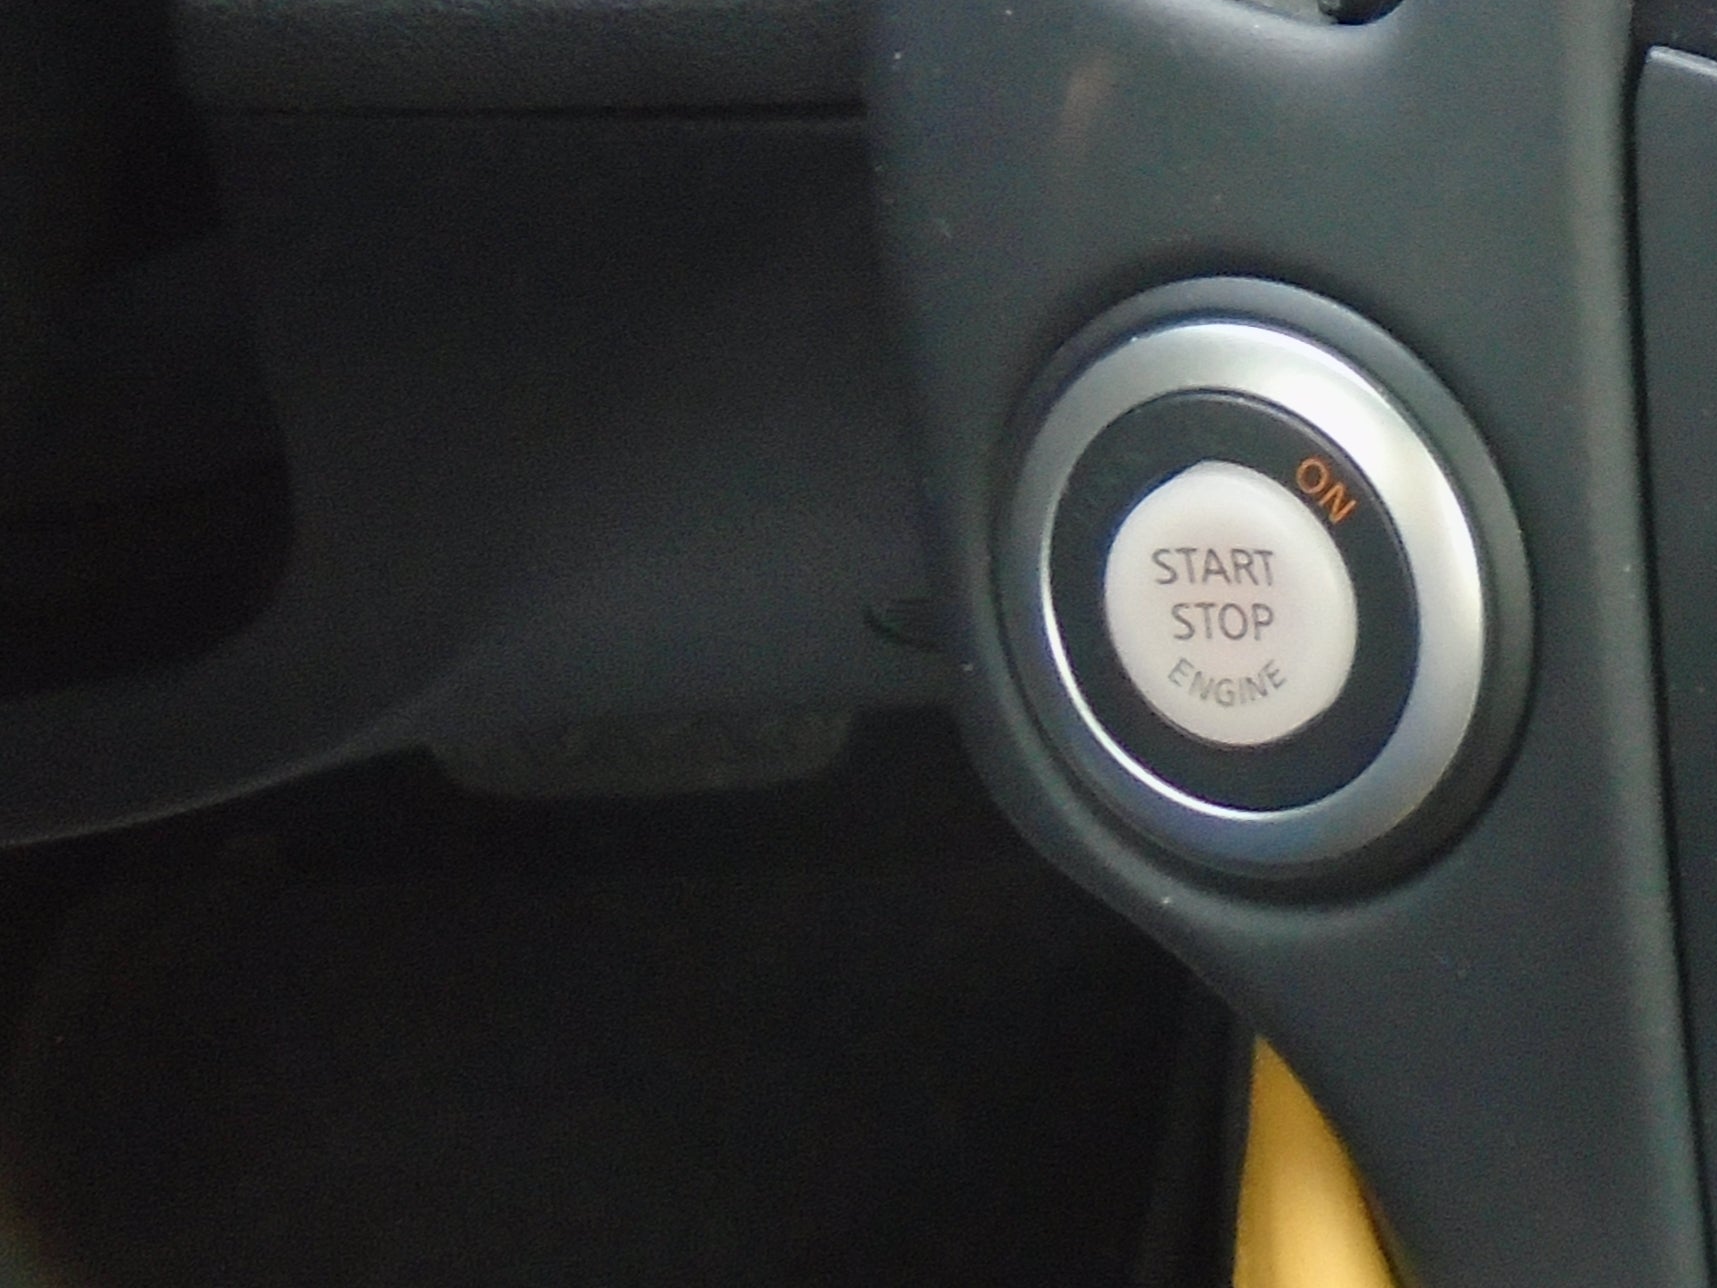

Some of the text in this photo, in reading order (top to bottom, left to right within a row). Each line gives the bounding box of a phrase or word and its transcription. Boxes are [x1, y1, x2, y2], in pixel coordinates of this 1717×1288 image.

[1296, 456, 1356, 524] ON
[1151, 548, 1274, 587] START
[1171, 602, 1275, 642] STOP
[1167, 657, 1288, 707] ENGINE
